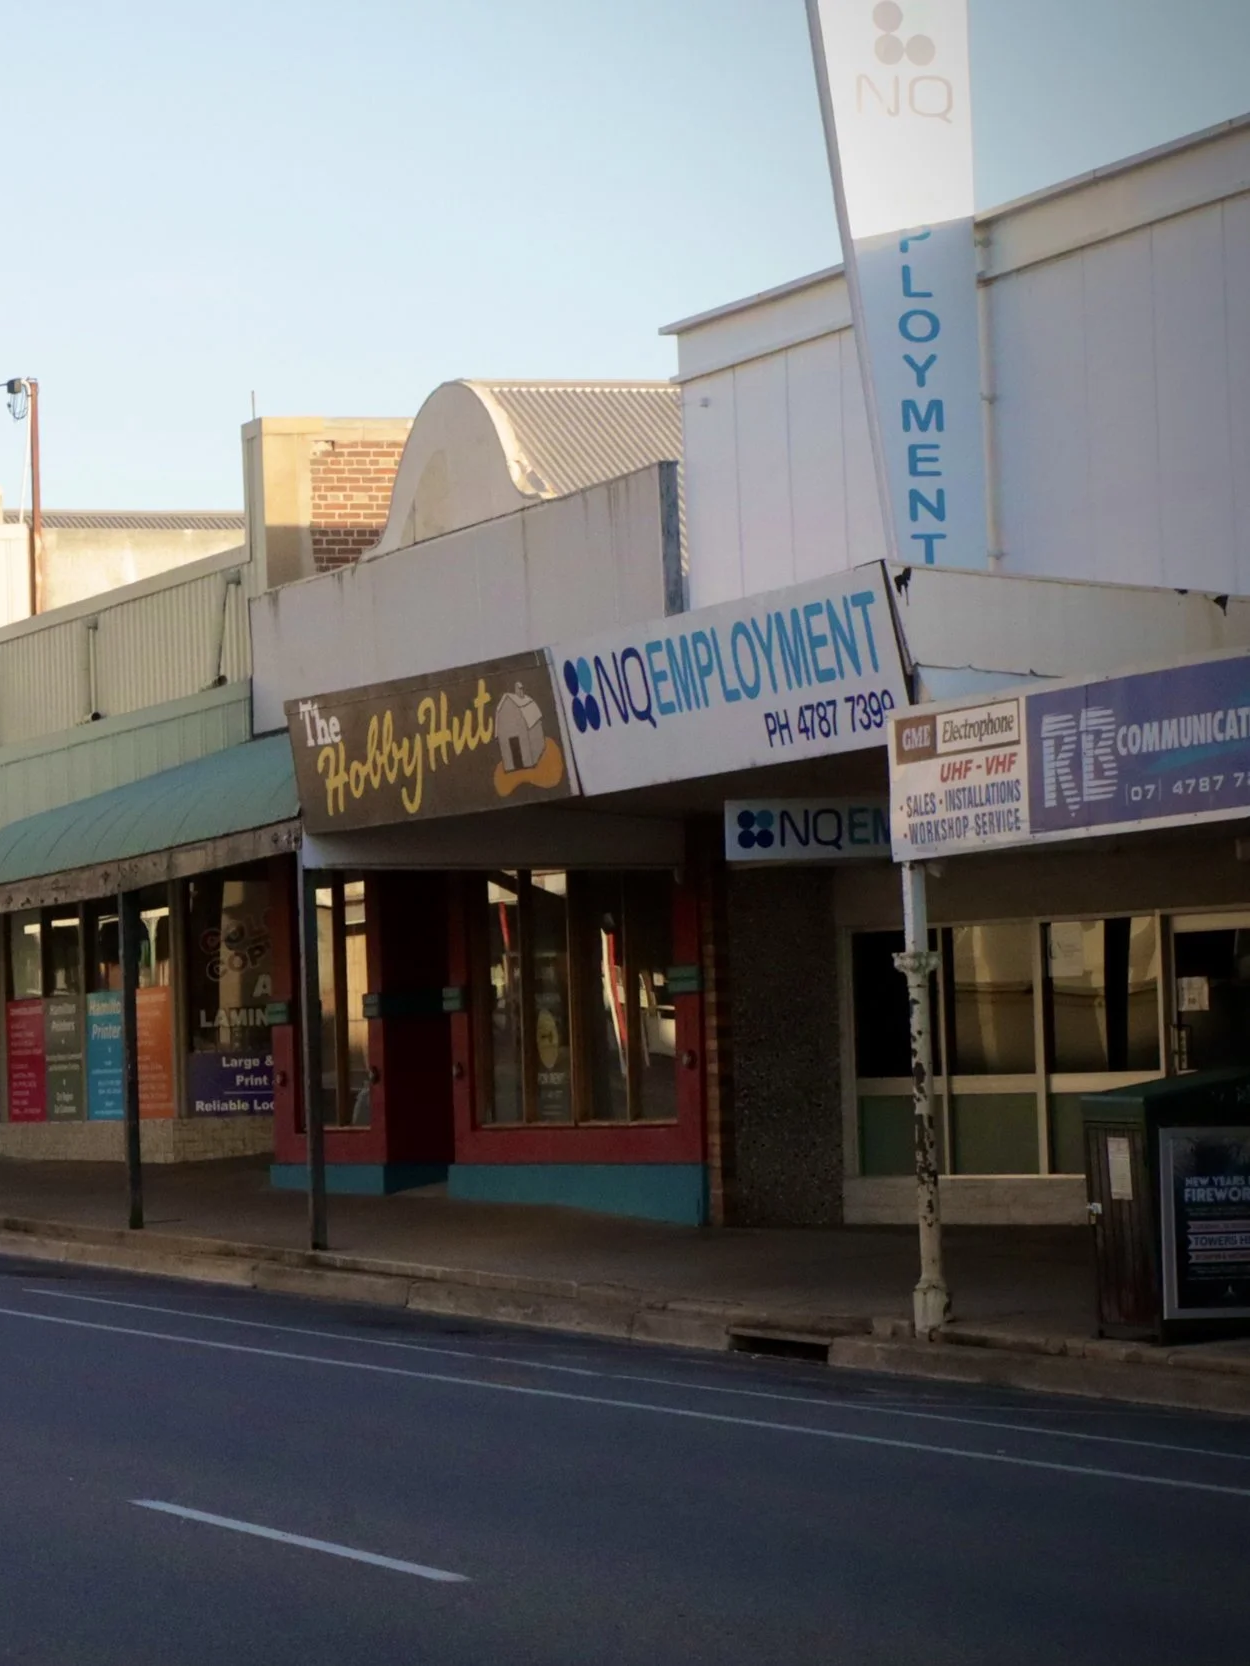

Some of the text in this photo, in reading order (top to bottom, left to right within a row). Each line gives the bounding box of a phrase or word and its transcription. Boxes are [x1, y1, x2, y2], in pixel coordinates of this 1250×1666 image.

[856, 74, 954, 124] NQ
[299, 700, 343, 747] The
[764, 709, 793, 748] PH
[797, 699, 839, 742] 4787
[902, 712, 1015, 751] GME Electrophone
[906, 779, 1022, 818] SALES INSTALLATIONS
[1172, 775, 1226, 796] 4787
[1233, 771, 1250, 788] 7
[908, 808, 1021, 845] WORKSHOP SERVICE
[222, 1056, 260, 1069] Large
[235, 1074, 269, 1086] Print
[195, 1099, 250, 1112] Reliable
